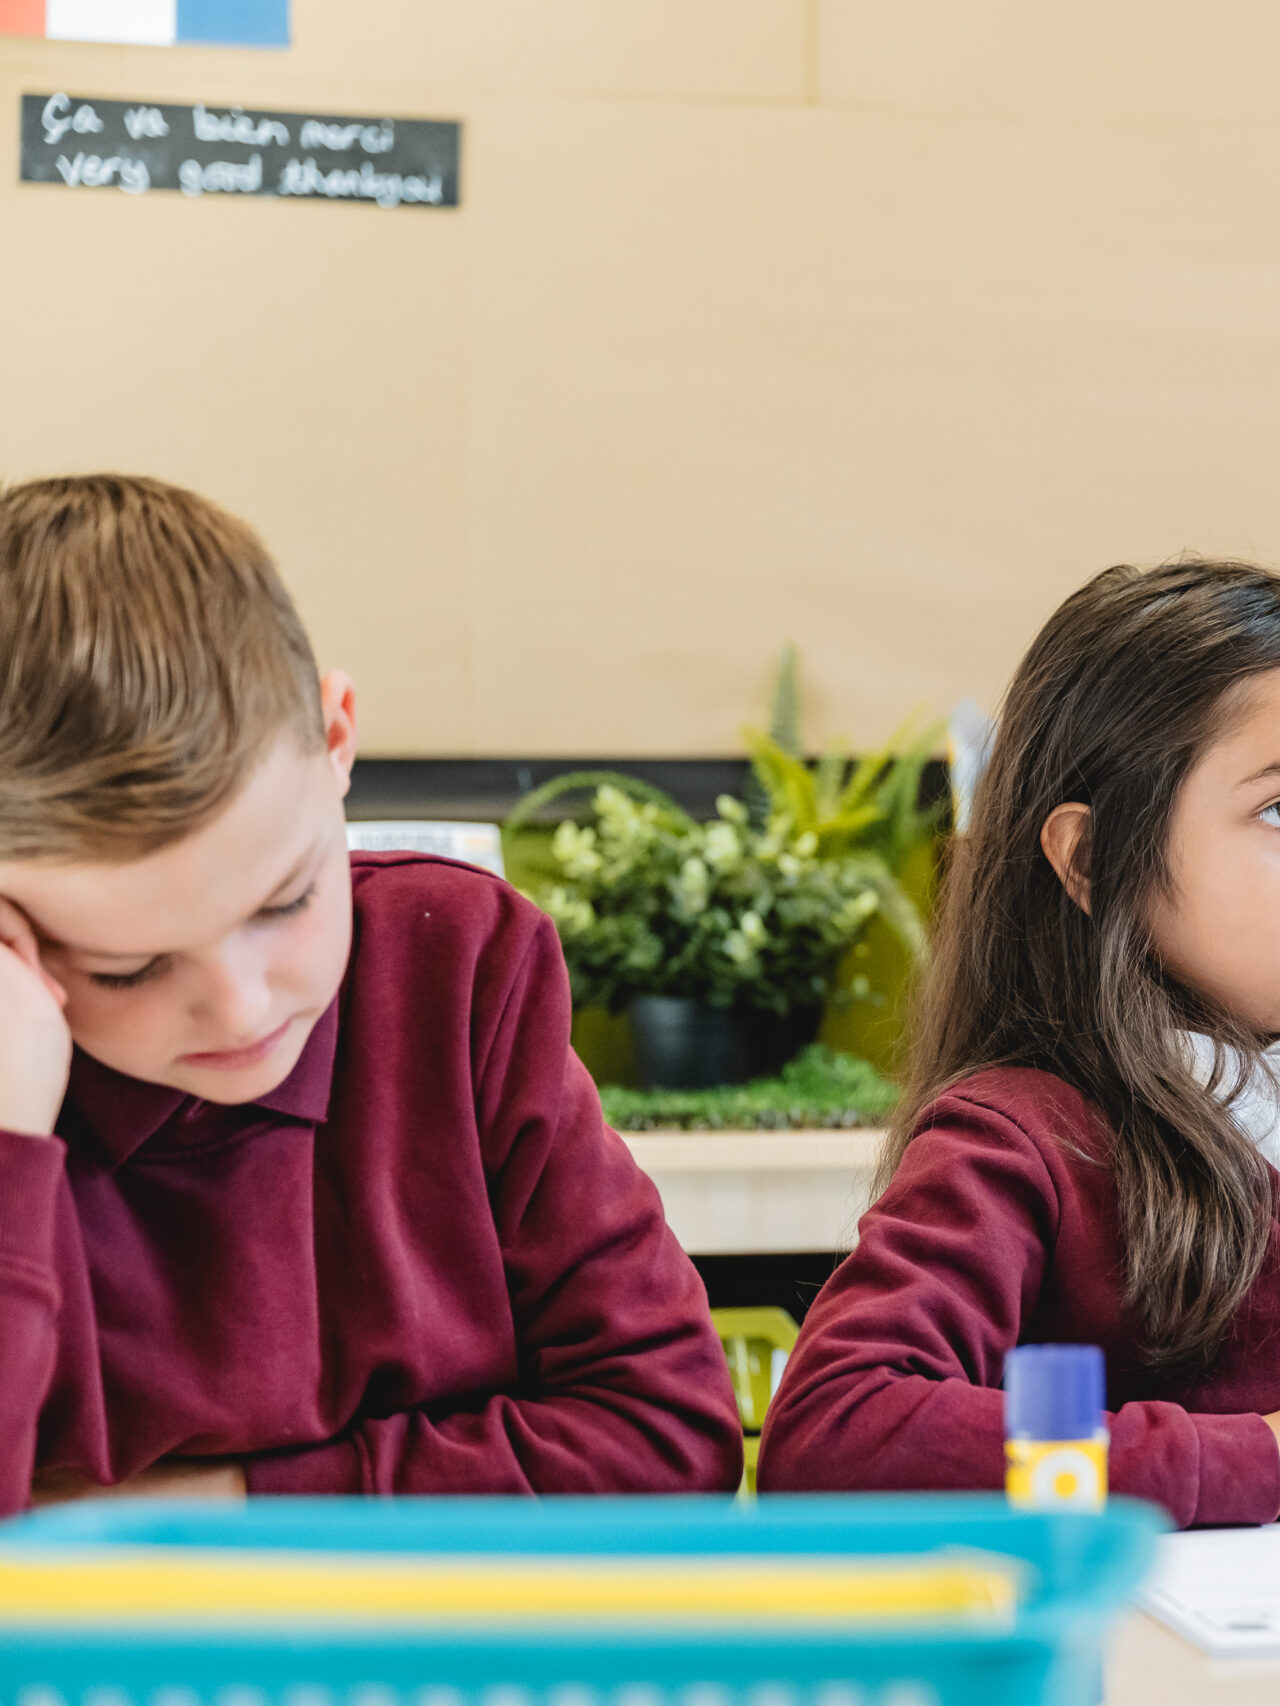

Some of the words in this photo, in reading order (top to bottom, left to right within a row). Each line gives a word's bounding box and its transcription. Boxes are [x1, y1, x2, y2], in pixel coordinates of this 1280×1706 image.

[41, 92, 104, 144] Ça
[123, 106, 169, 140] va
[193, 100, 289, 147] bien
[300, 118, 394, 153] merci
[55, 152, 150, 194] very
[178, 153, 262, 196] good
